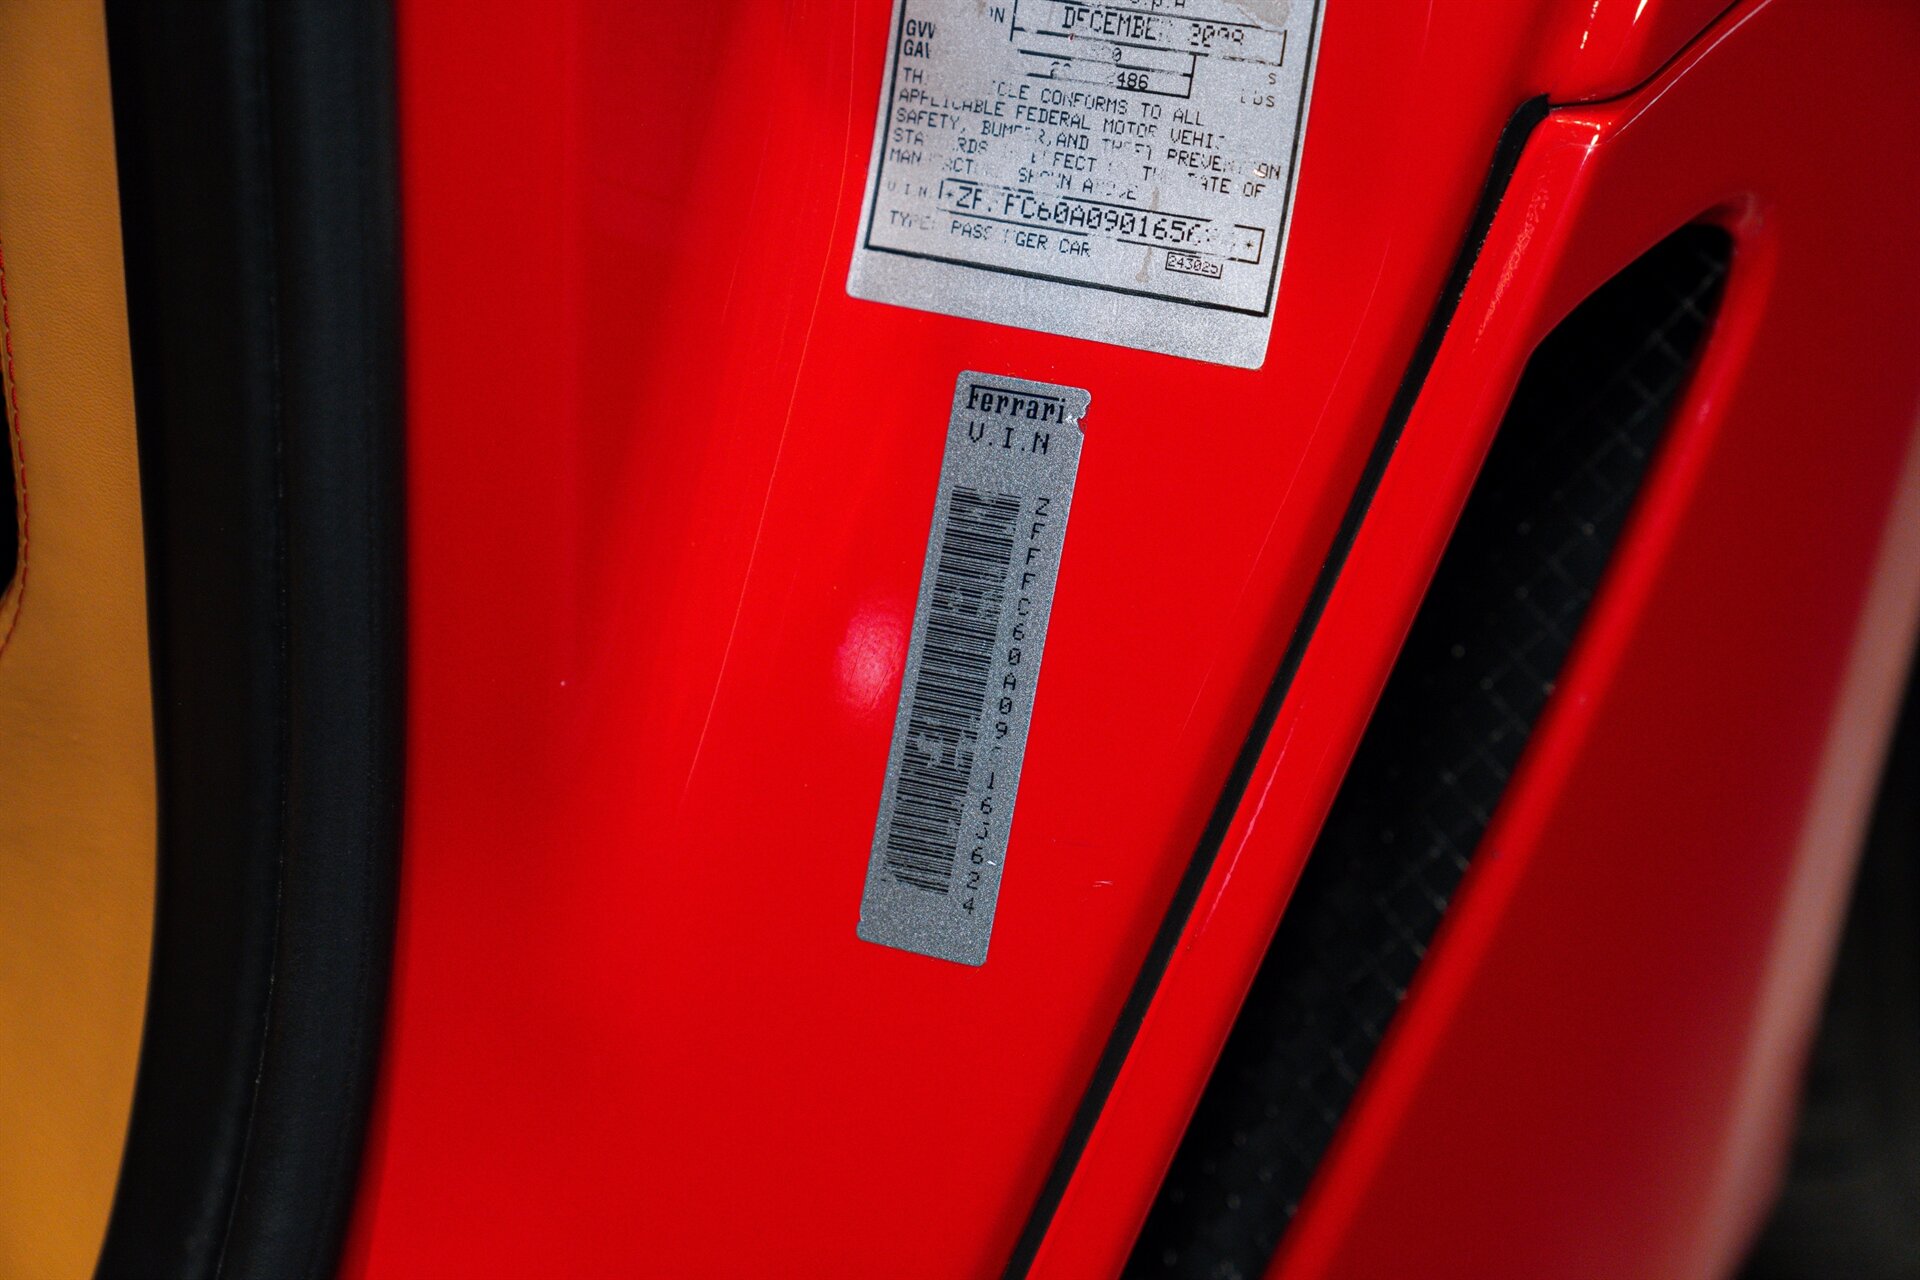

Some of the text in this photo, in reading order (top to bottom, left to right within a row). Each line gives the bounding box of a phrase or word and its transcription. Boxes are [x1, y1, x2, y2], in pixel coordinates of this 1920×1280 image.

[896, 107, 965, 134] SAFETY,
[1015, 104, 1090, 131] FEDERAL
[1141, 102, 1162, 120] TO
[1173, 108, 1204, 126] ALL
[1243, 182, 1266, 198] OF
[965, 384, 1066, 424] Ferrari
